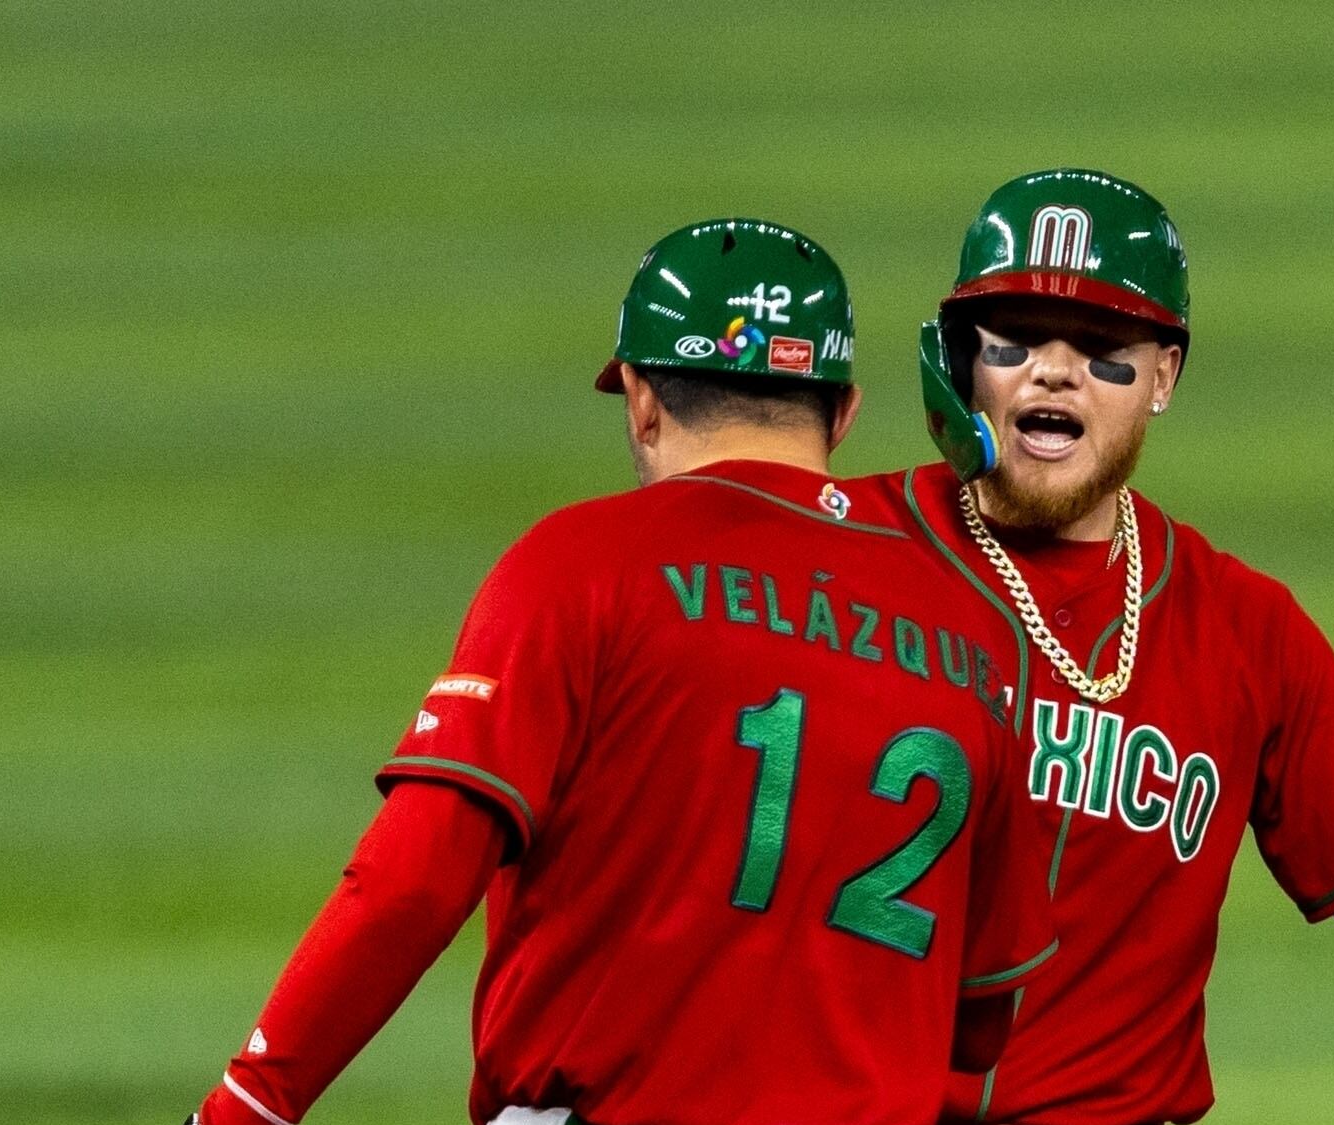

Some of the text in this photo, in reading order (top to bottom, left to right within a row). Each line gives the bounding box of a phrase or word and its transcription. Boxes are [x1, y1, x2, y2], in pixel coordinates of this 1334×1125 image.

[752, 282, 792, 324] 12
[731, 687, 972, 960] 12
[1027, 697, 1221, 863] XICO
